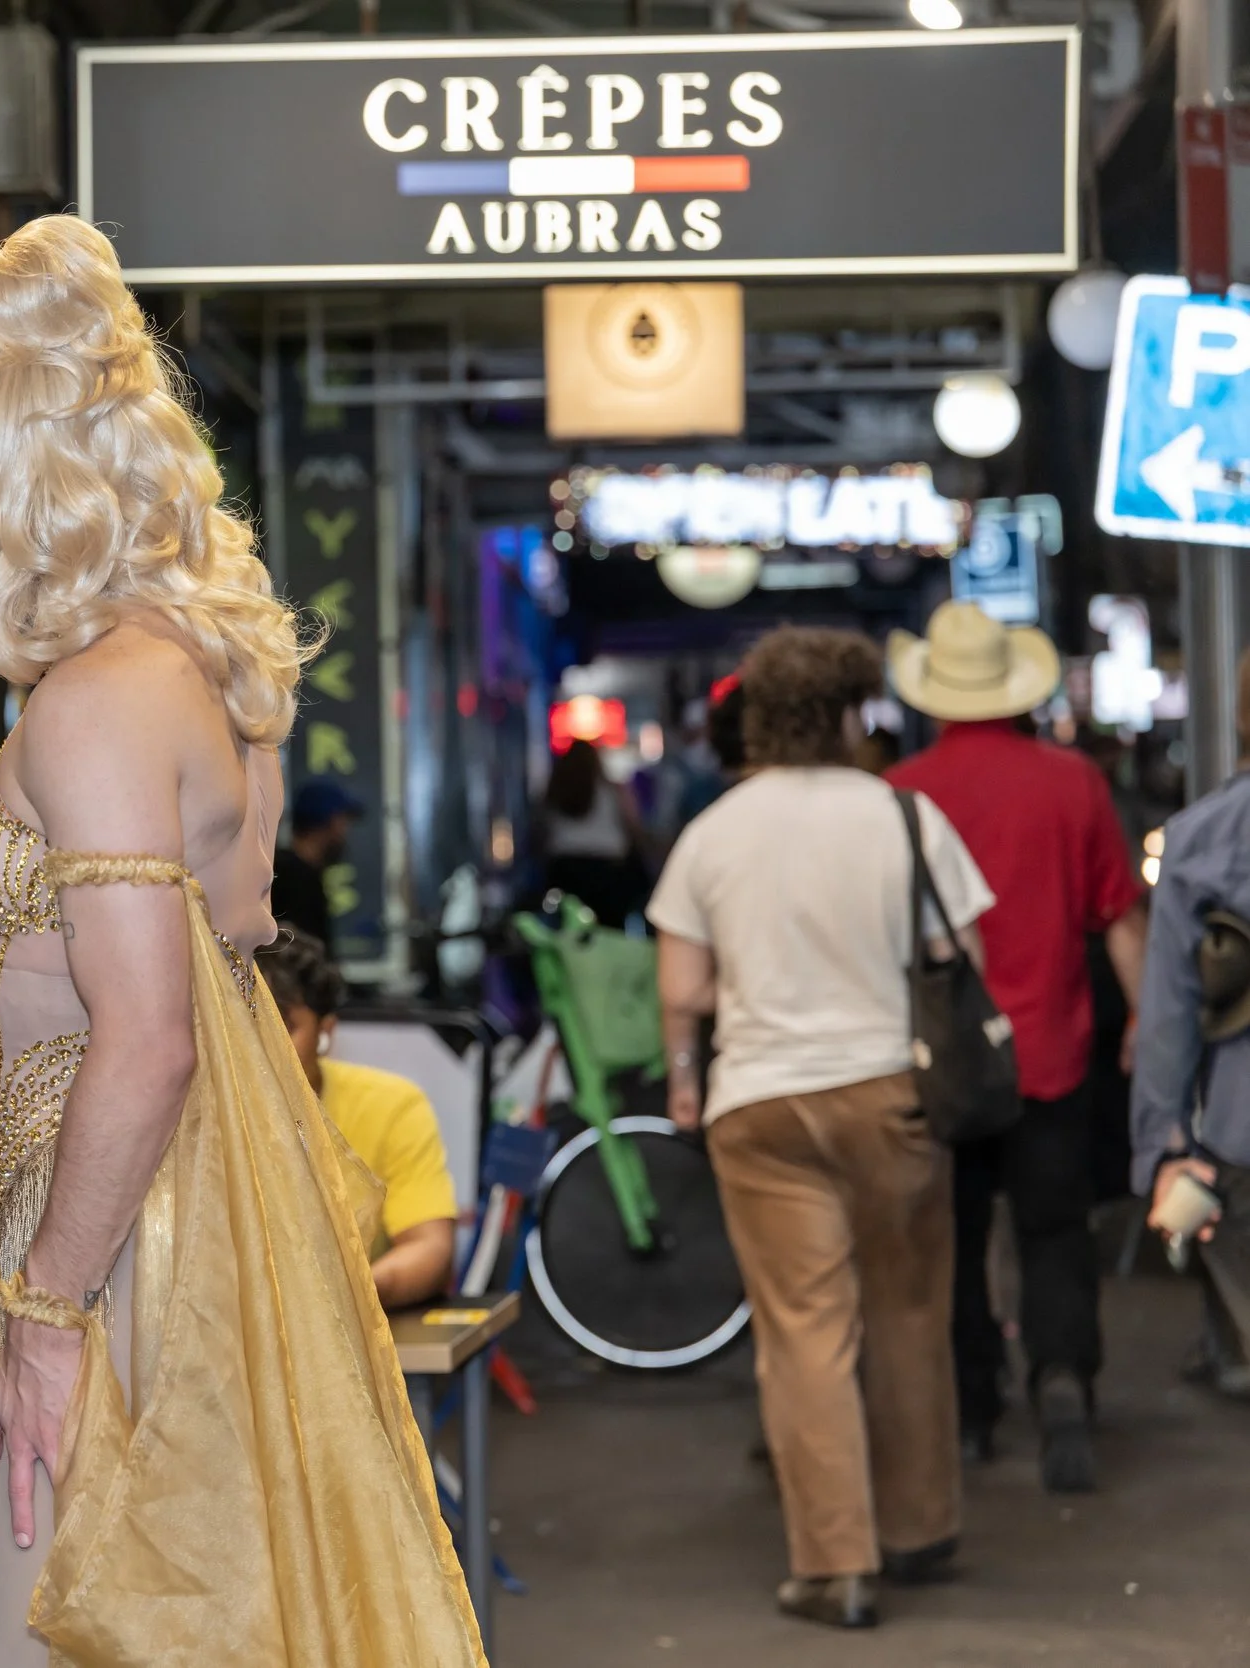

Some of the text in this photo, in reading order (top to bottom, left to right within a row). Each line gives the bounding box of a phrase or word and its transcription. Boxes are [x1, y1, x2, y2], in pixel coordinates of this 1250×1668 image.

[362, 63, 785, 153] CRÊPES
[425, 198, 723, 255] AUBRAS
[1167, 303, 1250, 409] P
